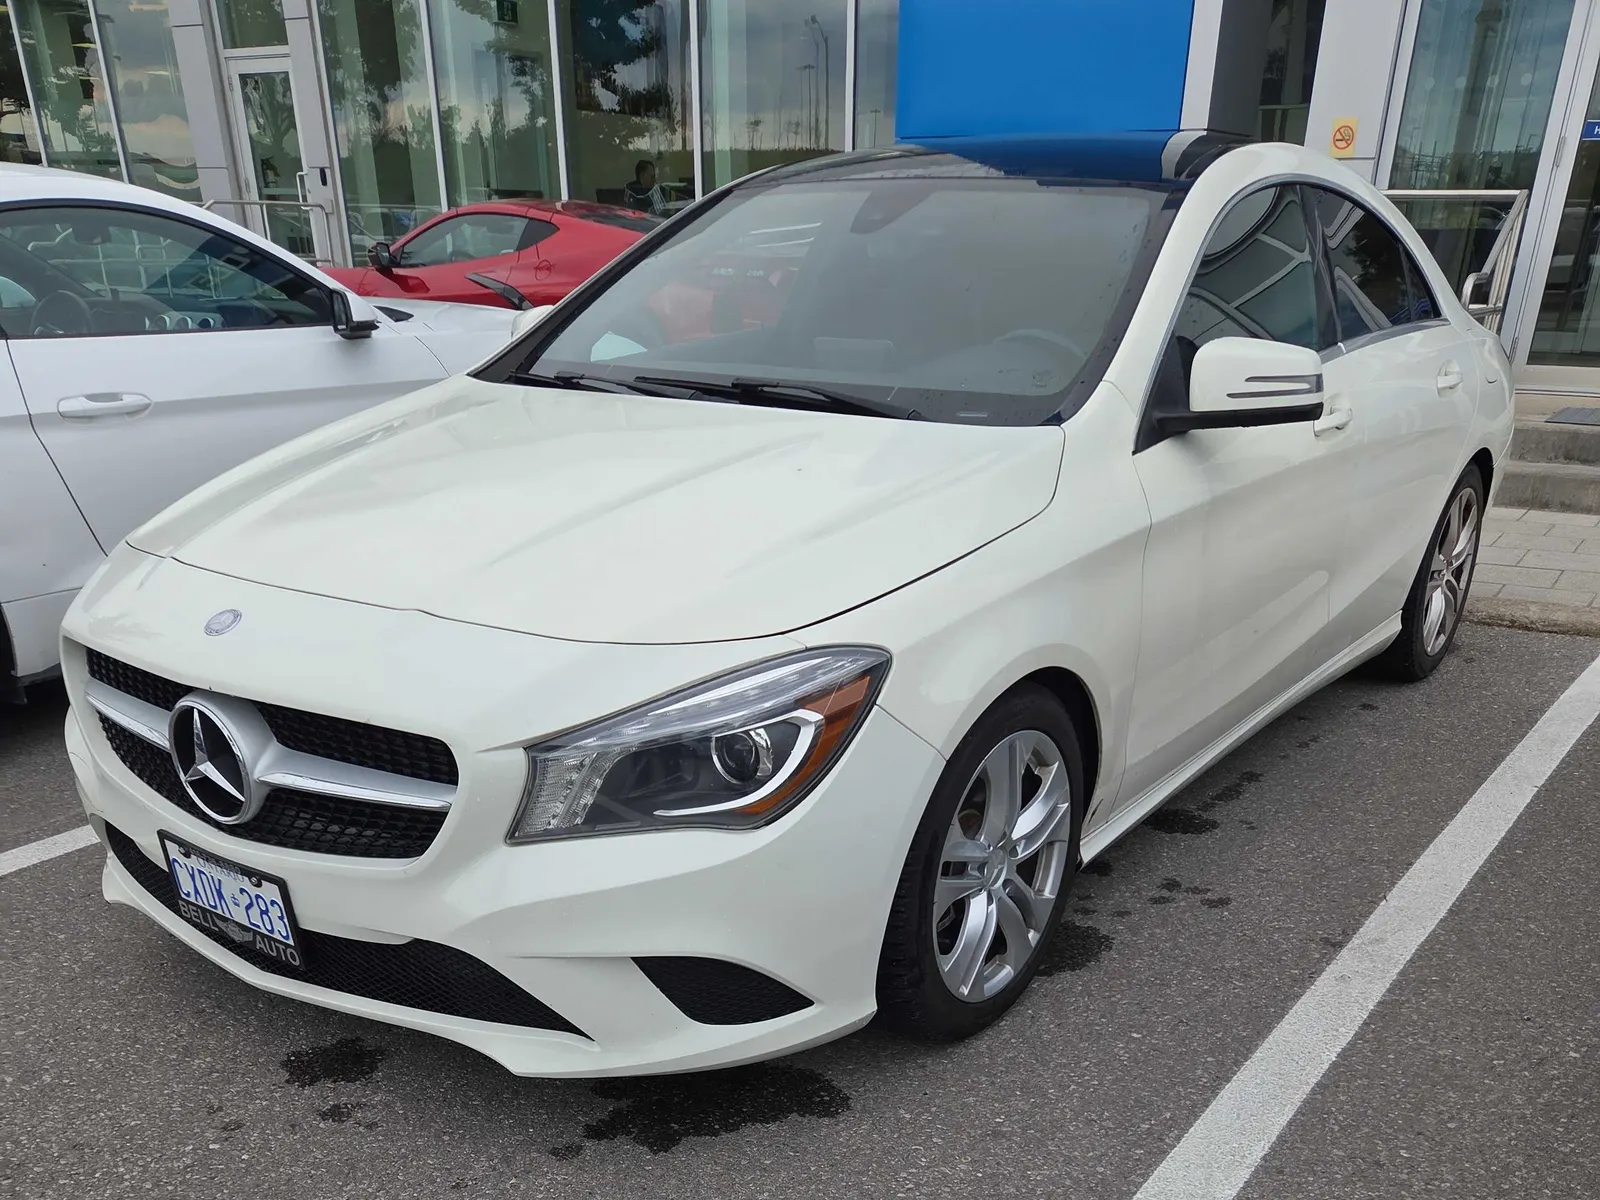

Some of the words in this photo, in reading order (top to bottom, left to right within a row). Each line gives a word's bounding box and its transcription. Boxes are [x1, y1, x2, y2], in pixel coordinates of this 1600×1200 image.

[171, 857, 235, 919] CXDK
[239, 887, 290, 941] 283
[177, 900, 219, 932] BELL
[256, 934, 300, 966] AUTO
